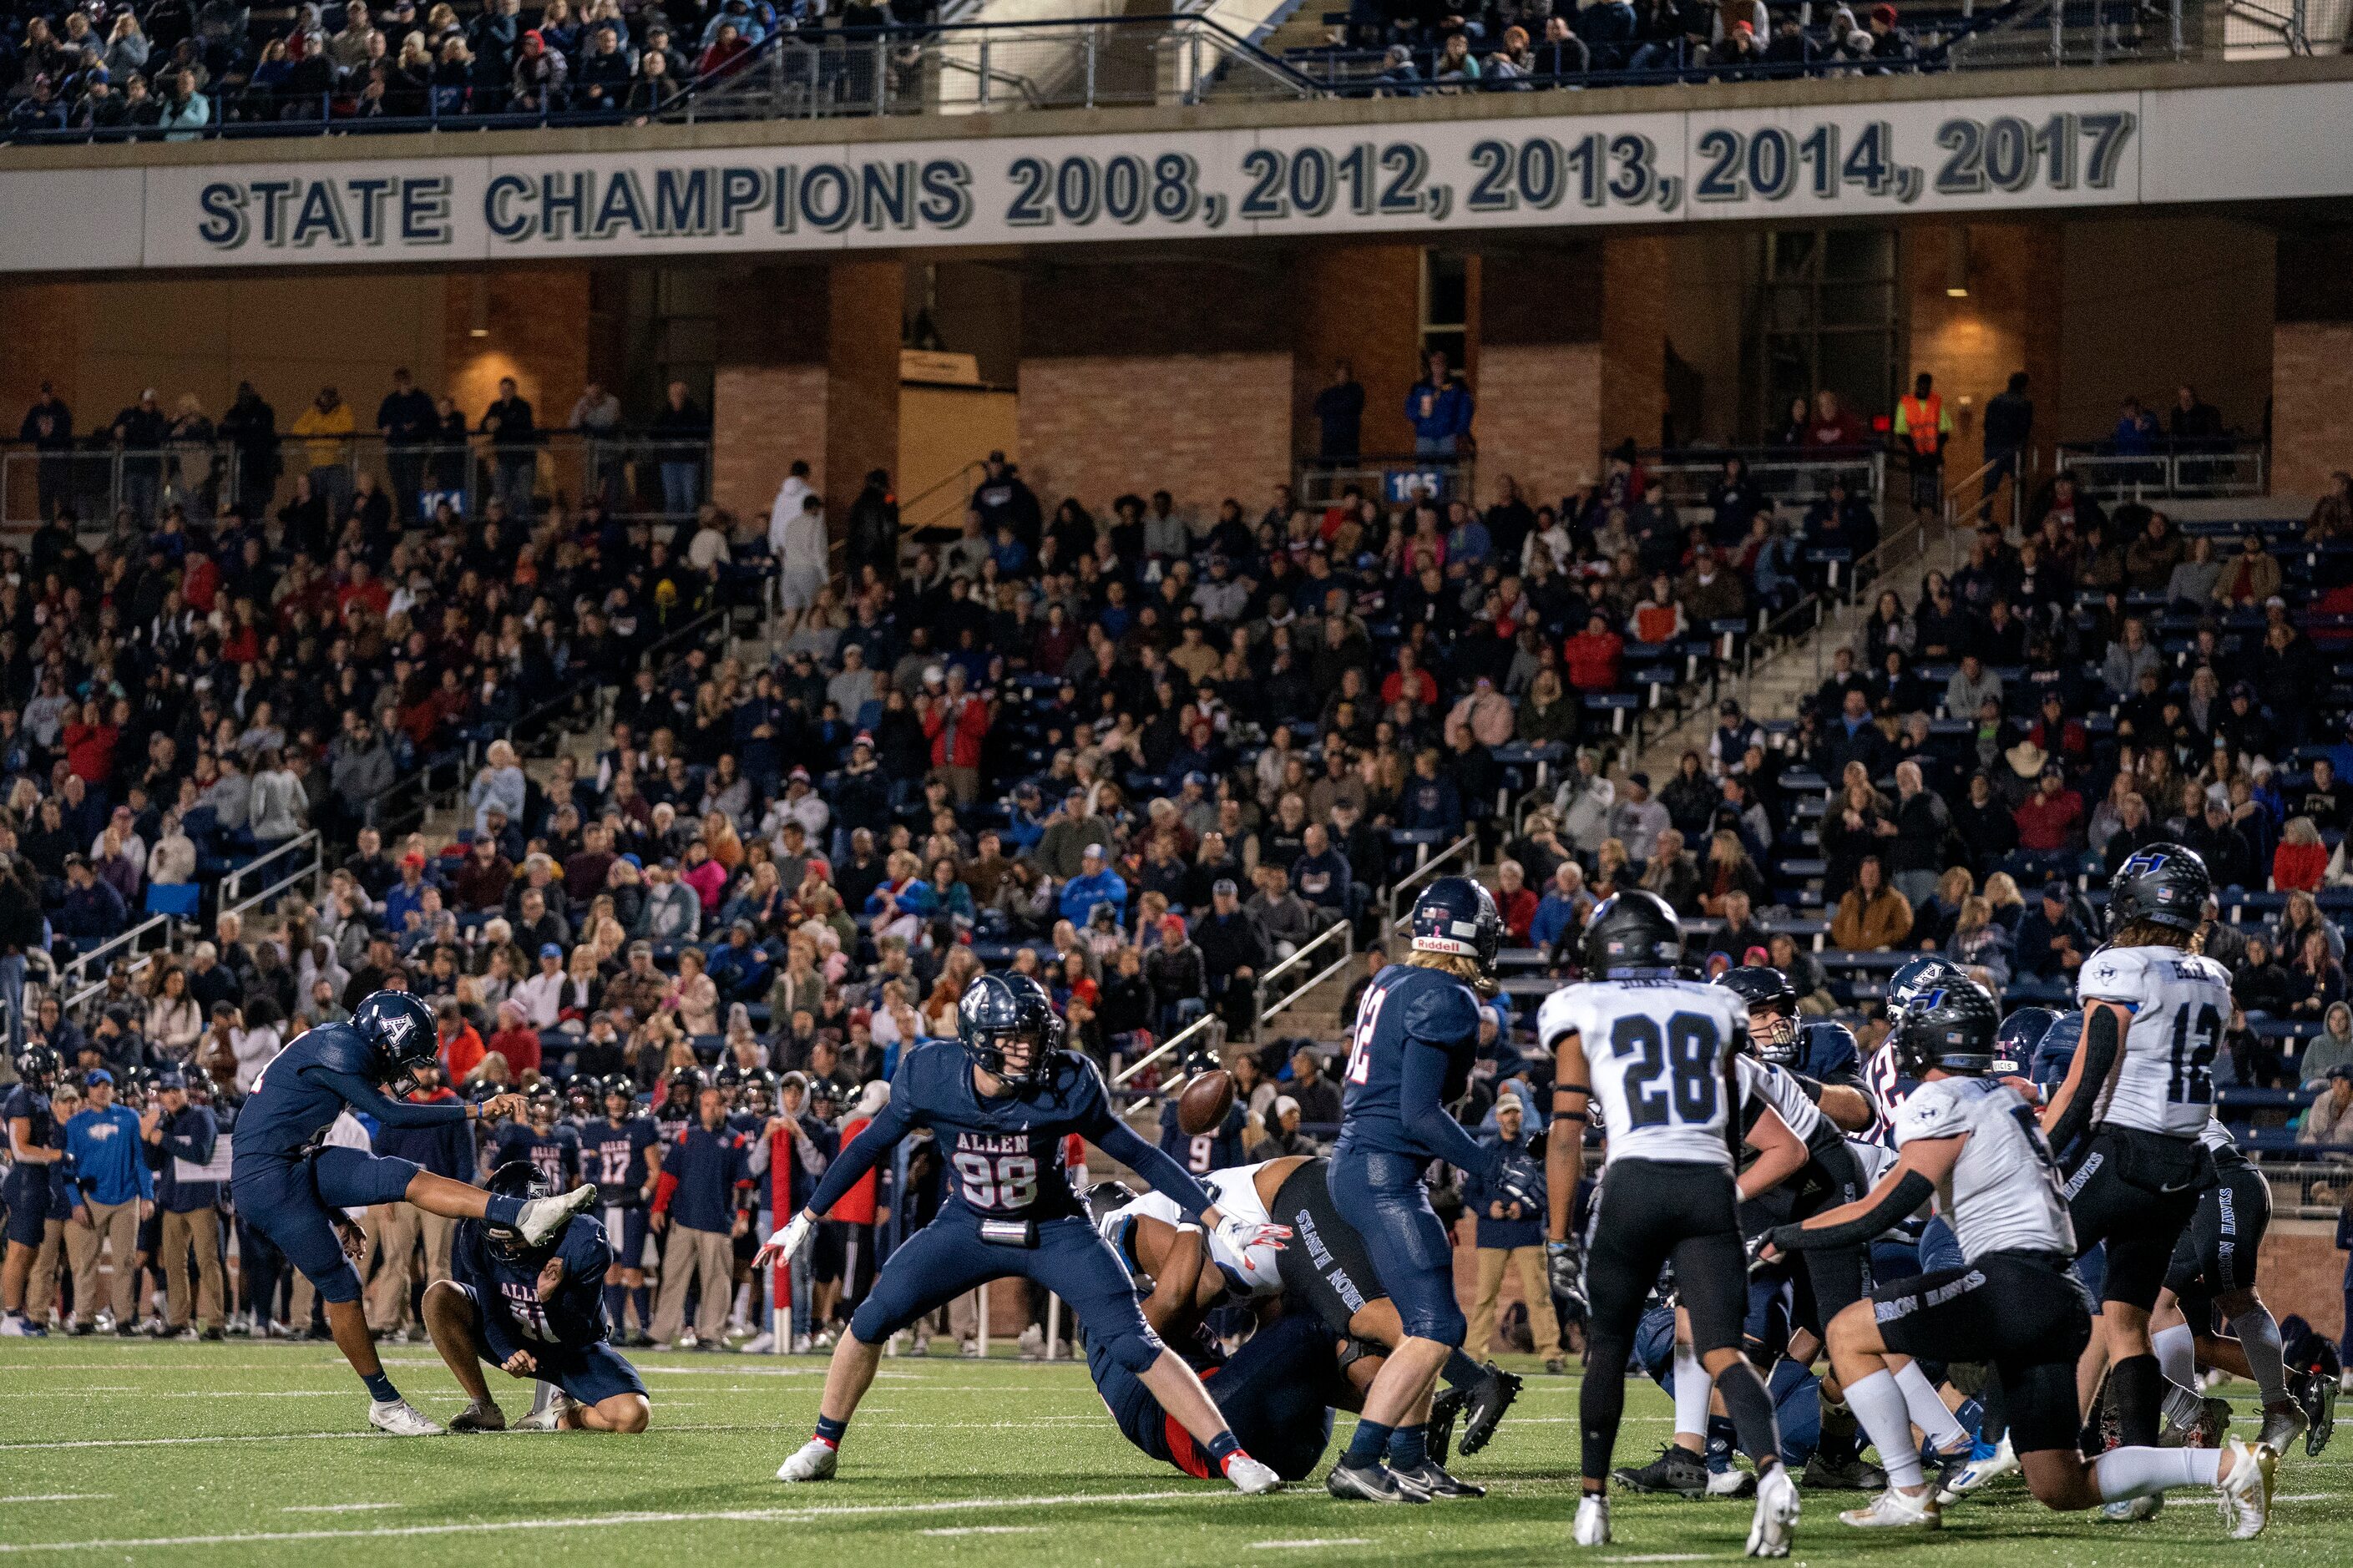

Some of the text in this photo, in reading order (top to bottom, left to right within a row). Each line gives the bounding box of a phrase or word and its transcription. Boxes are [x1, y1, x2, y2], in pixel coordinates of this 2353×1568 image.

[199, 111, 2137, 250] STATE CHAMPIONS 2008, 2012, 2013, 2014, 2017
[1418, 939, 1460, 952] Riddell
[379, 1013, 417, 1048] A
[2168, 1002, 2221, 1104] 12
[1612, 1010, 1720, 1130] 28
[1865, 1041, 1906, 1129] 2
[601, 1152, 630, 1184] 17
[957, 1132, 1029, 1154] ALLEN
[1189, 1136, 1212, 1173] 9
[952, 1151, 1039, 1211] 98
[2219, 1187, 2236, 1236] HAWKS
[1295, 1209, 1334, 1271] HAWKS
